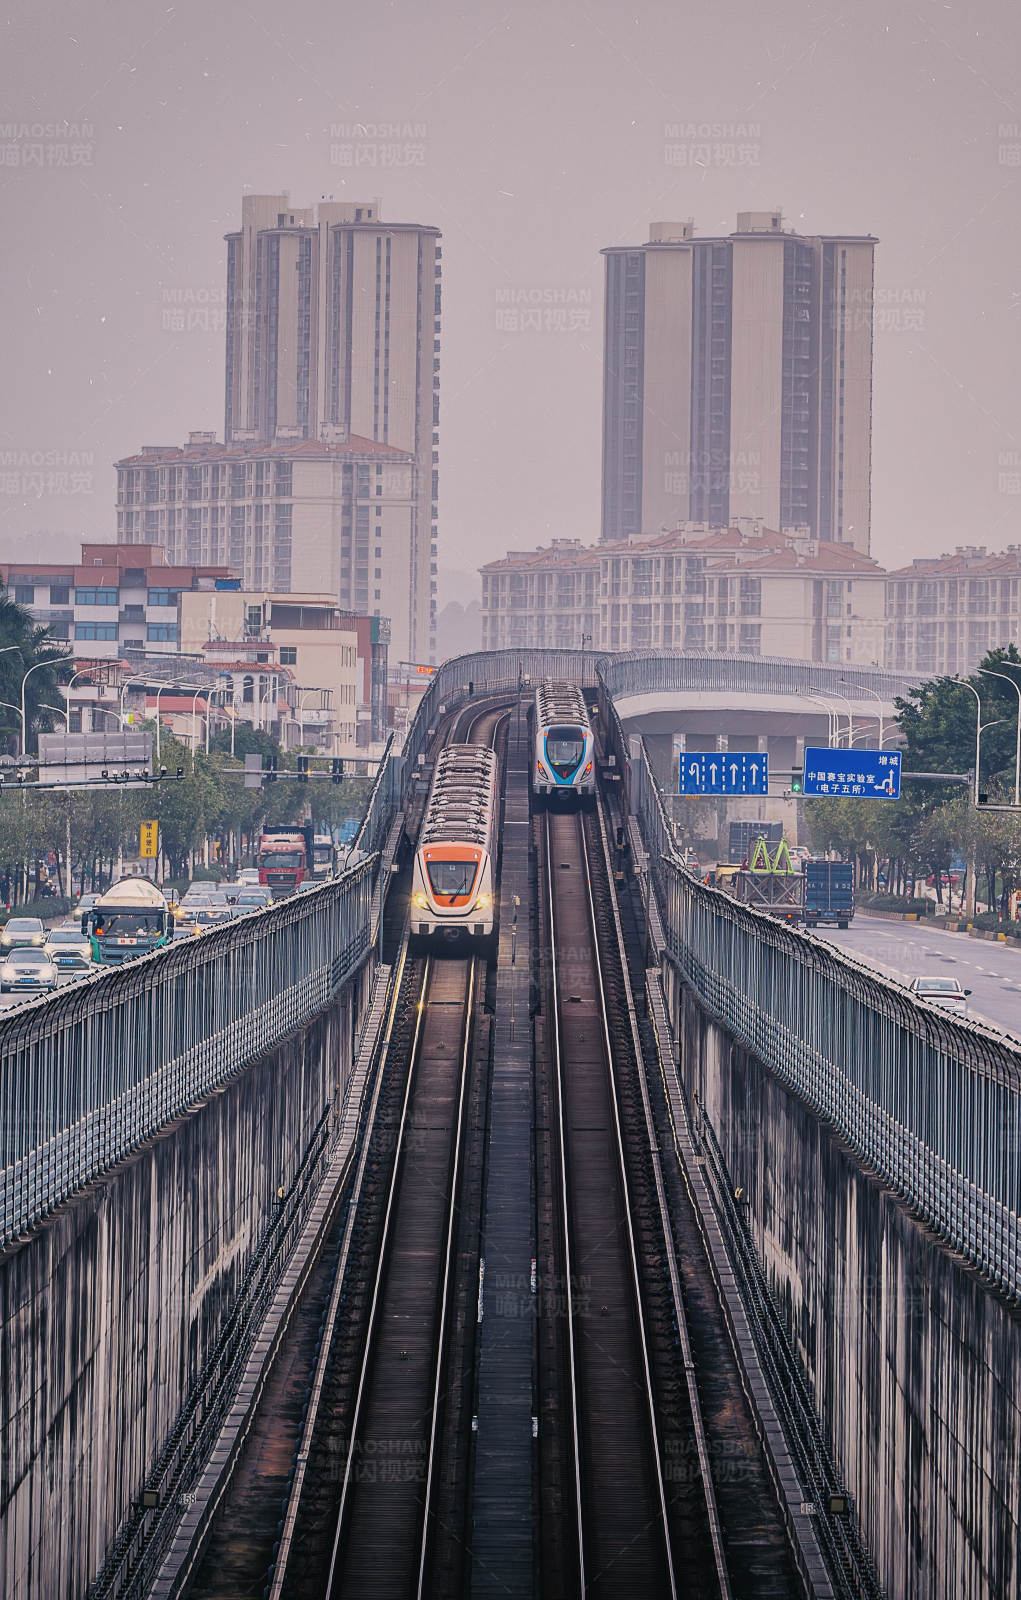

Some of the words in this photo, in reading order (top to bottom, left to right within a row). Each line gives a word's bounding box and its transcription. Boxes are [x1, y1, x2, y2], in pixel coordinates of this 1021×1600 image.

[879, 756, 898, 766] 增城
[808, 772, 875, 784] 中国赛宝实验室
